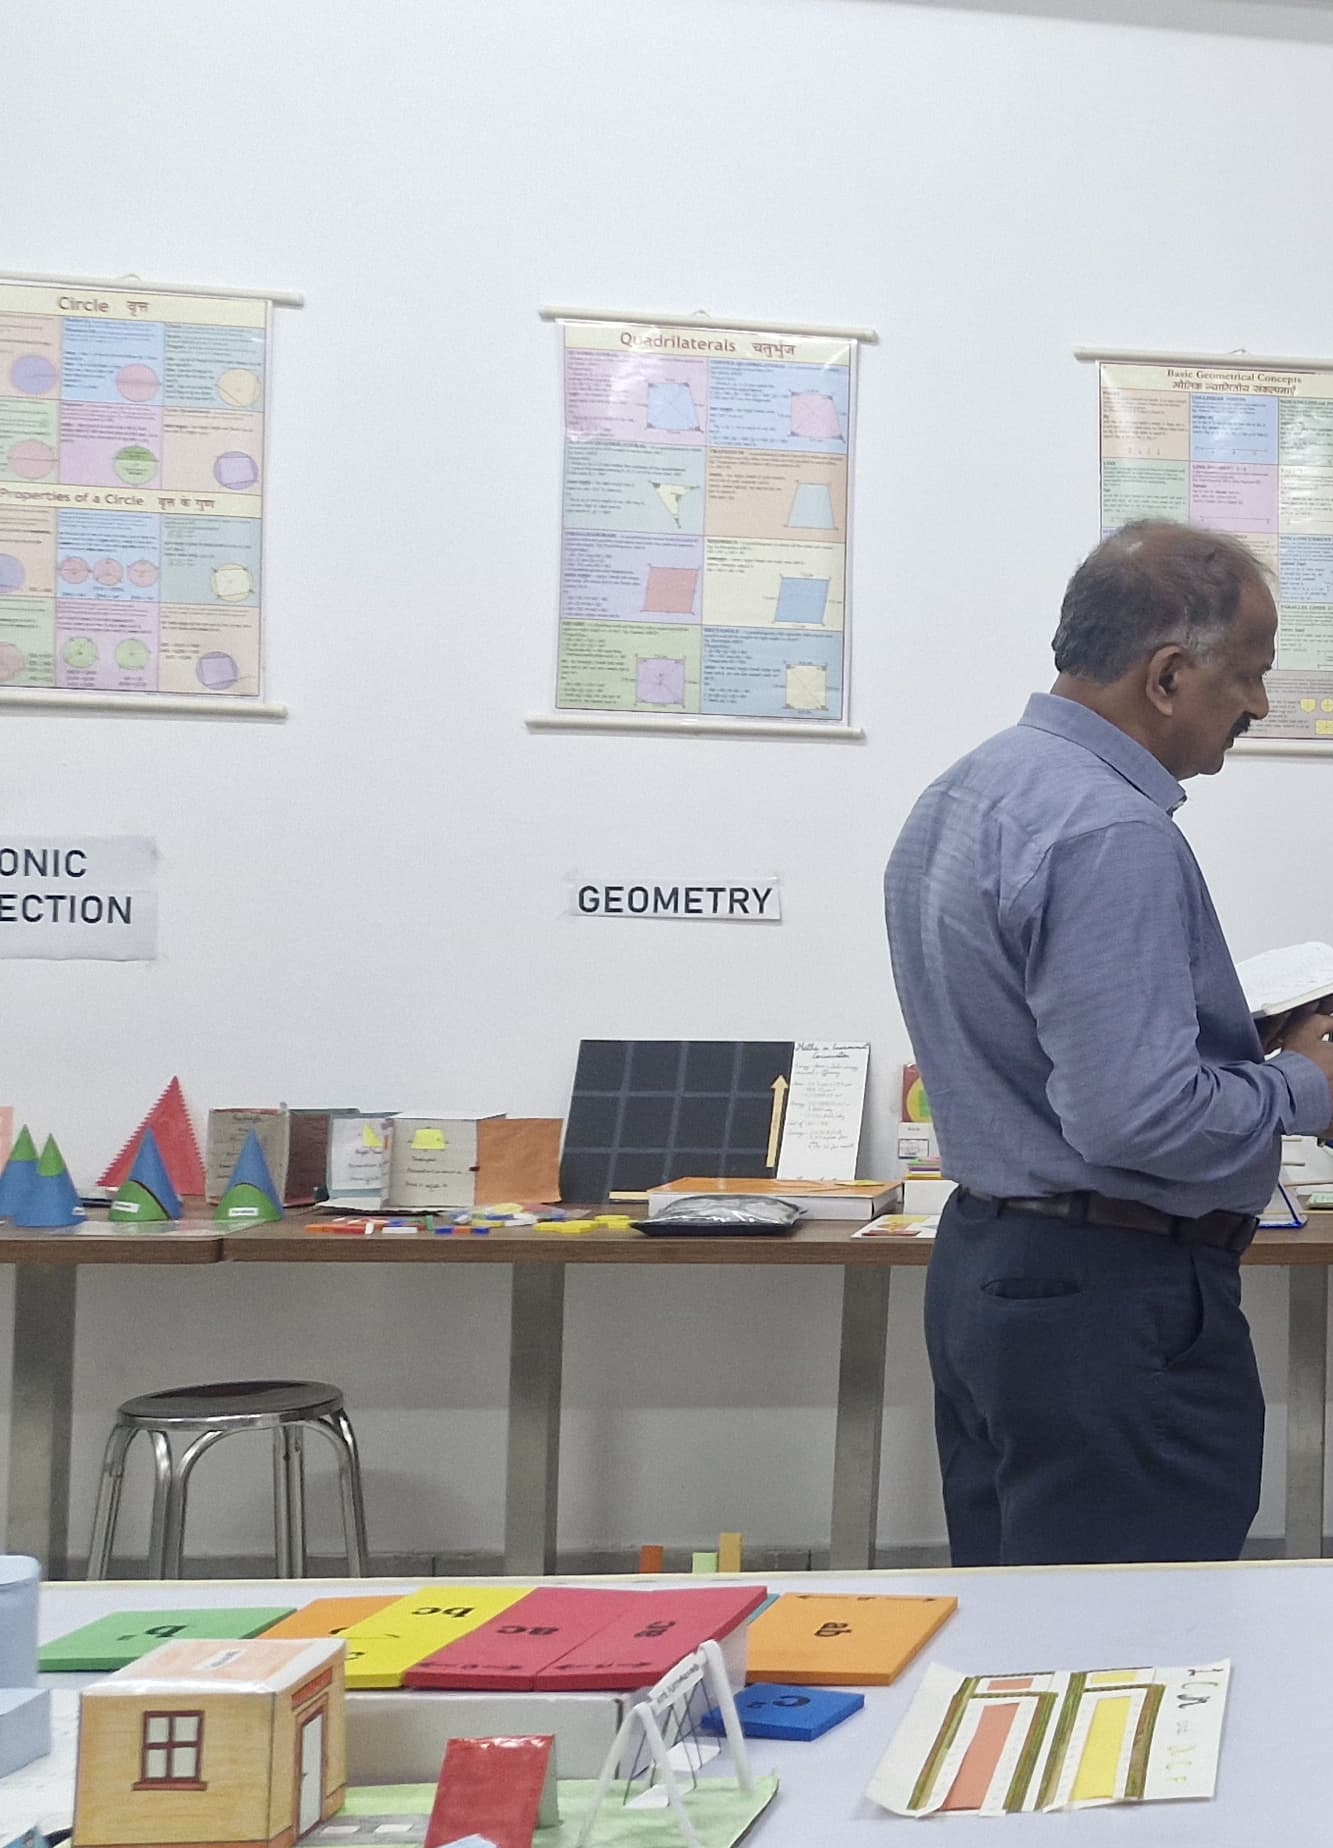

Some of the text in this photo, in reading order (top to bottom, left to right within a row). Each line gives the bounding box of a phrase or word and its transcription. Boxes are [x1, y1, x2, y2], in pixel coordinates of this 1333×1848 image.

[58, 296, 110, 313] Circle
[620, 332, 736, 352] Quadrilaterals
[1167, 369, 1302, 385] Basic Geometrical Concepts
[74, 492, 89, 503] of
[93, 496, 101, 504] a
[104, 494, 145, 506] Circle
[0, 848, 88, 878] ONIC
[0, 894, 132, 924] ECTION
[578, 885, 772, 914] GEOMETRY
